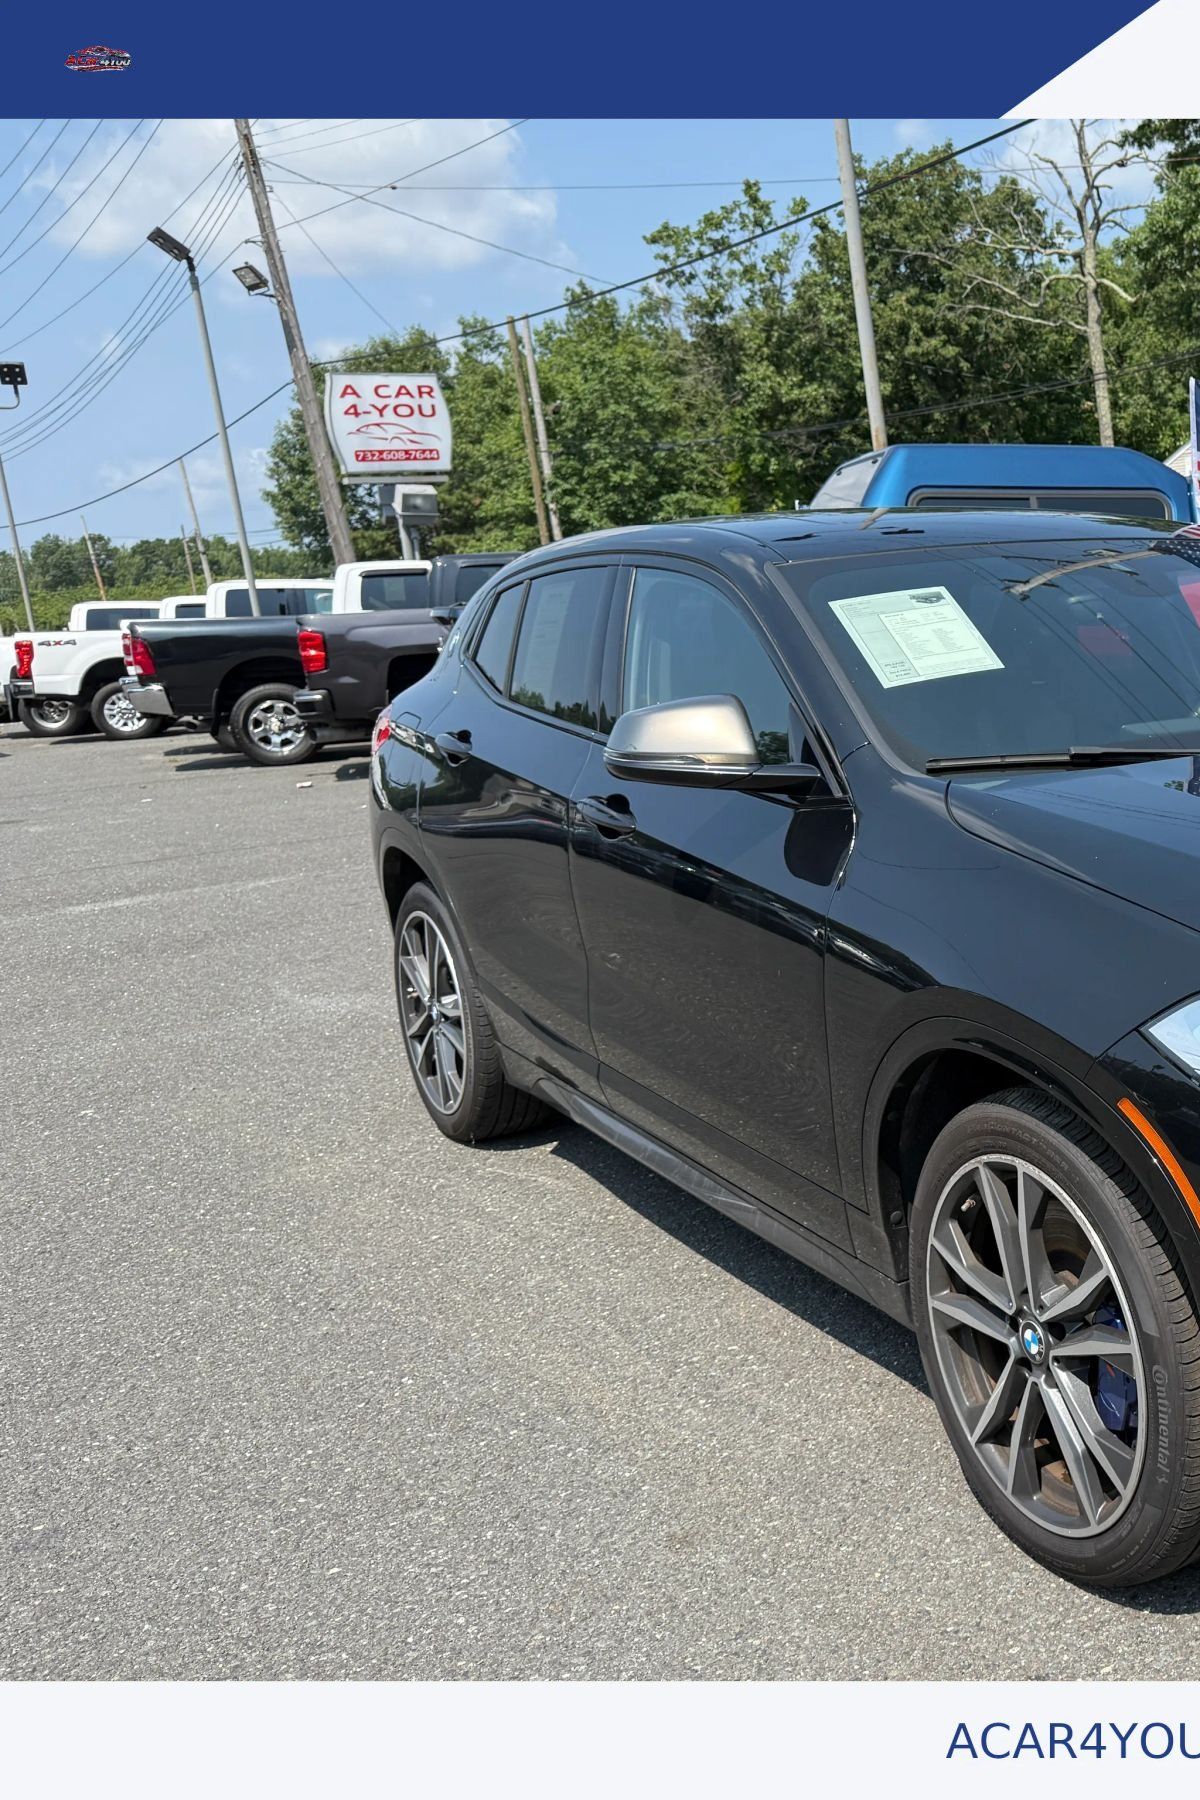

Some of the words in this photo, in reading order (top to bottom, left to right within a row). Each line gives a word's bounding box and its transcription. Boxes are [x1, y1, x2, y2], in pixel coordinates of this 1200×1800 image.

[340, 384, 362, 399] A
[373, 384, 436, 399] CAR
[343, 403, 437, 418] 4-YOU
[355, 450, 439, 461] 732-608-7644
[1152, 1364, 1171, 1473] Continental
